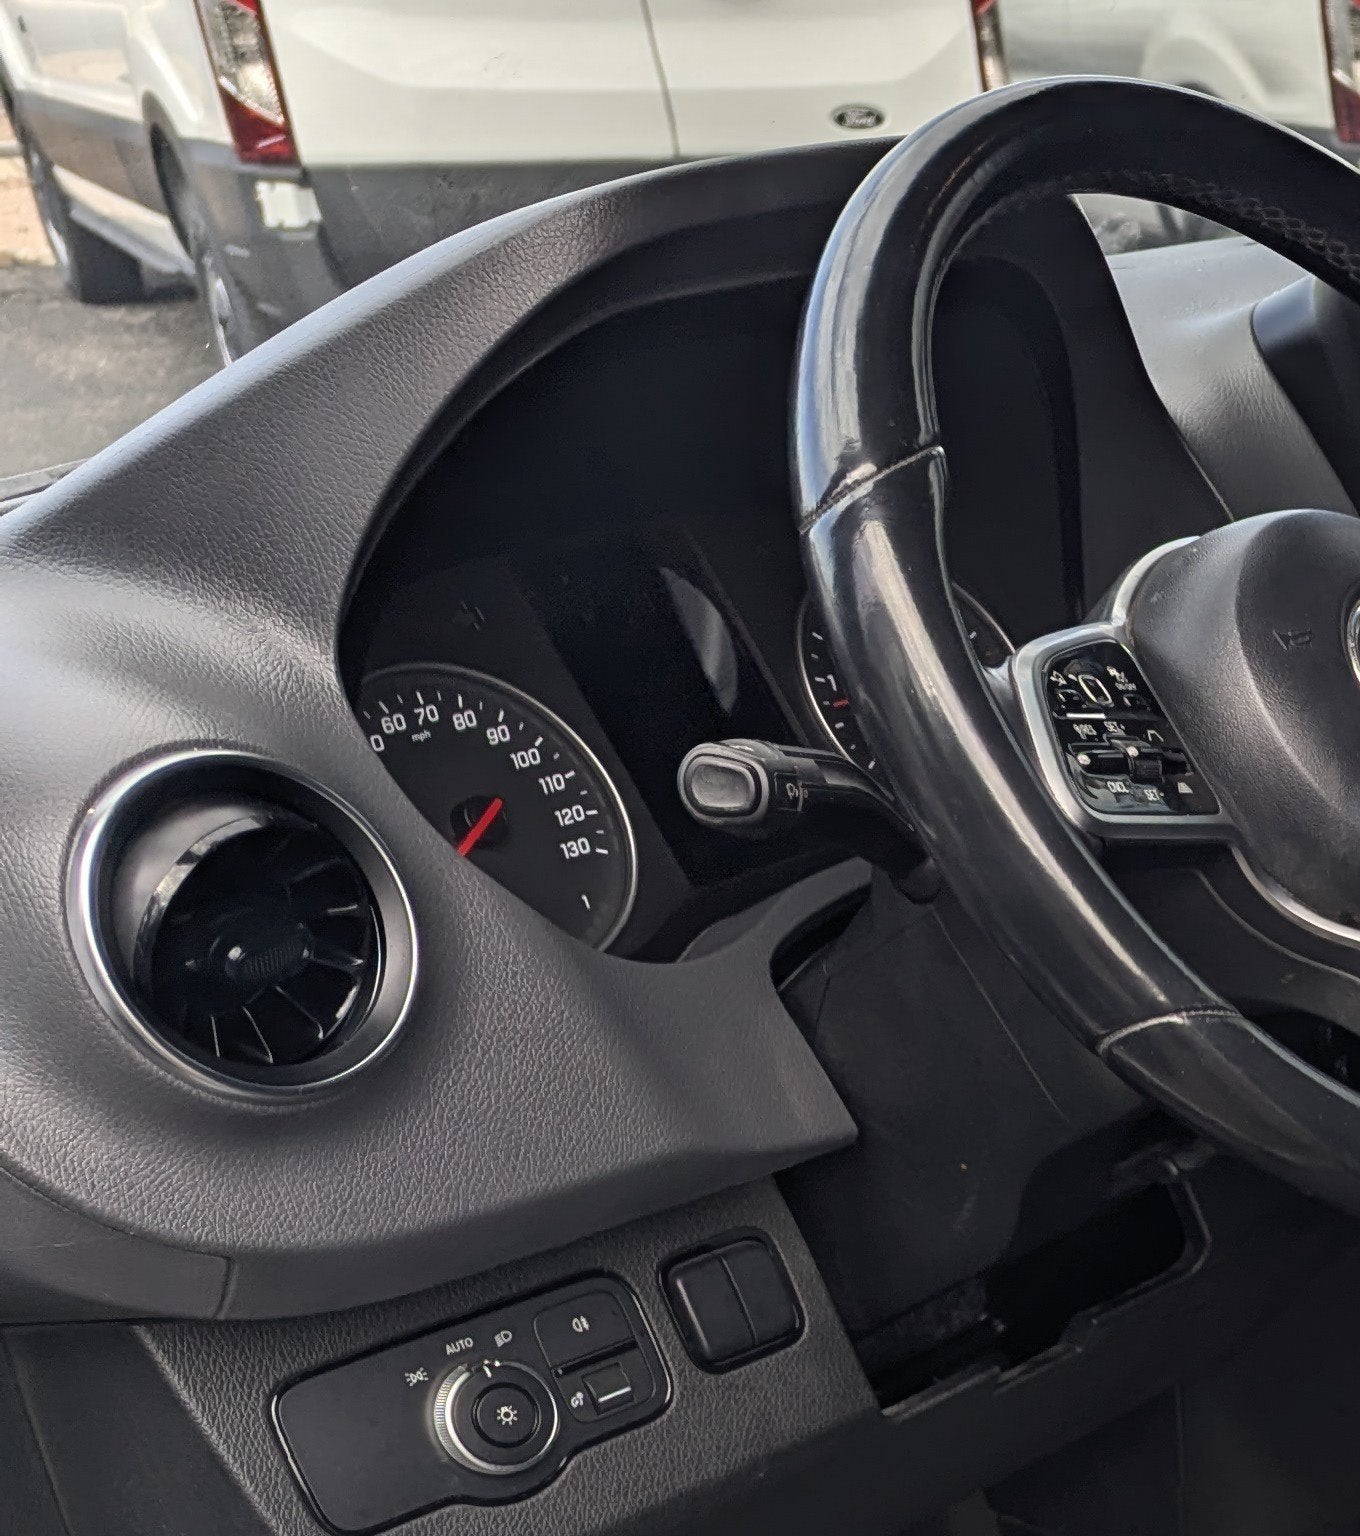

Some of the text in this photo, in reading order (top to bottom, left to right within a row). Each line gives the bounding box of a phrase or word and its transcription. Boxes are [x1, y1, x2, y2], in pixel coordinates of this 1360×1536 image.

[380, 712, 407, 734] 60
[414, 704, 439, 726] 70
[452, 709, 477, 730] 80
[411, 729, 431, 742] mph
[486, 724, 511, 746] 90
[510, 747, 541, 770] 100
[538, 773, 566, 796] 110
[554, 804, 585, 827] 120
[559, 837, 590, 859] 130
[445, 1337, 474, 1355] AUTO
